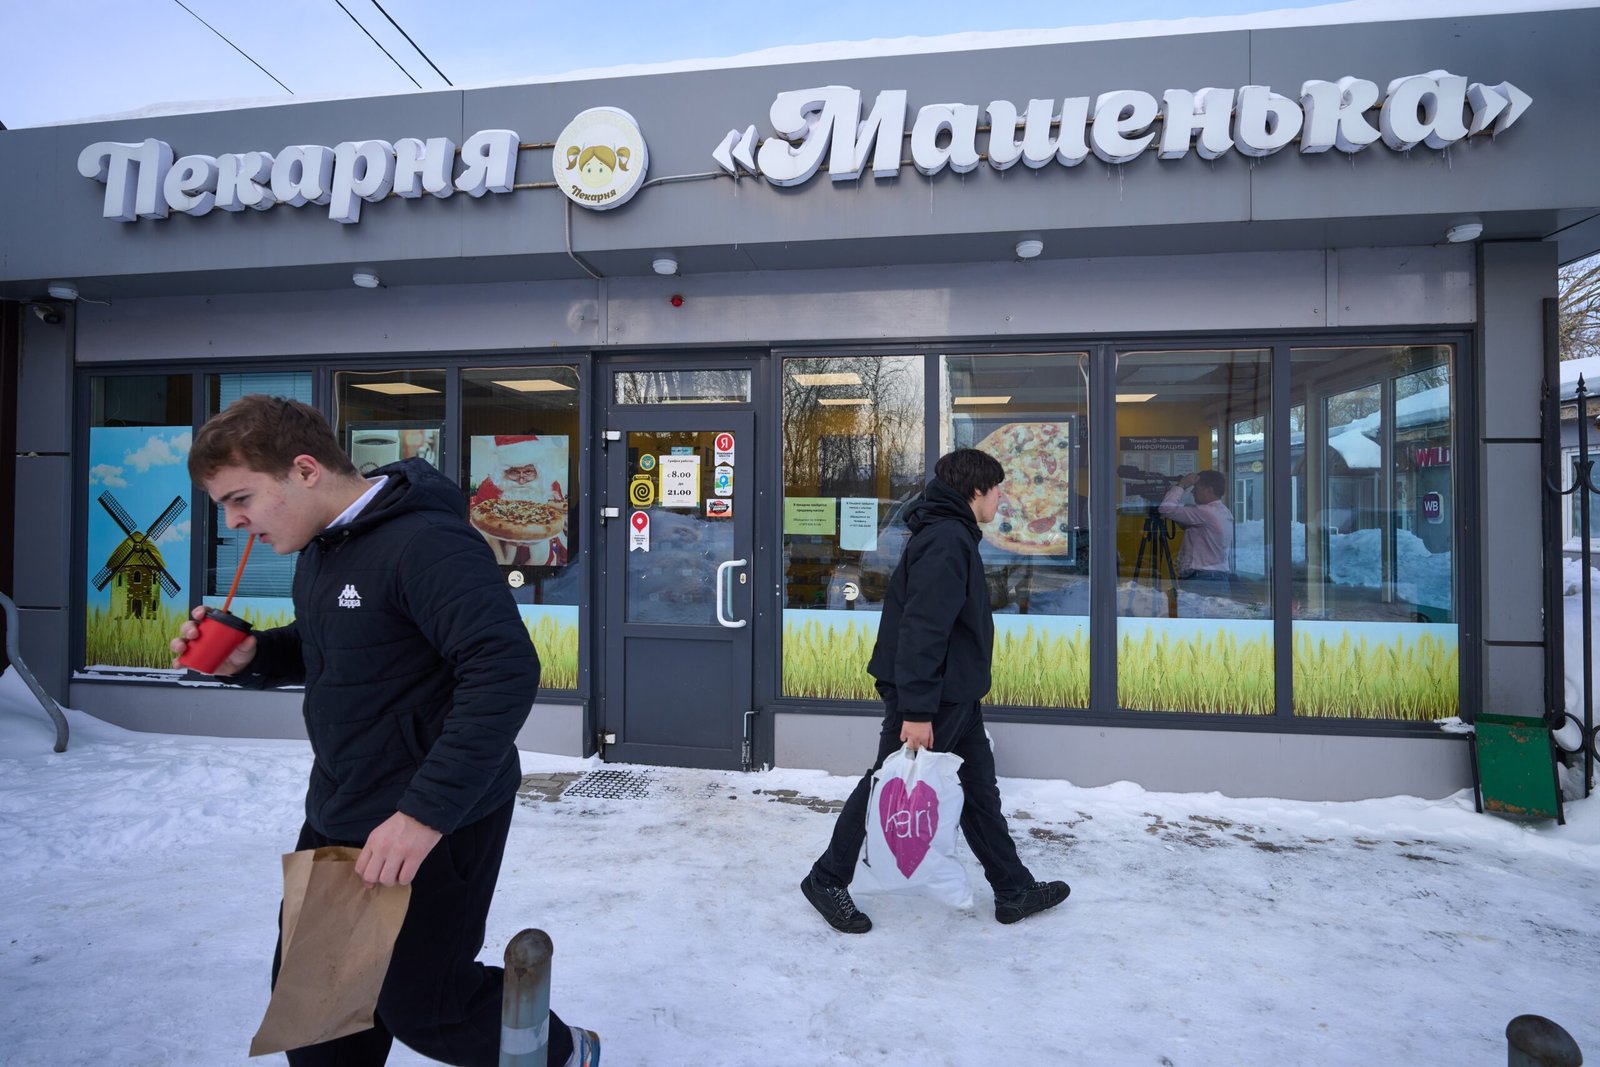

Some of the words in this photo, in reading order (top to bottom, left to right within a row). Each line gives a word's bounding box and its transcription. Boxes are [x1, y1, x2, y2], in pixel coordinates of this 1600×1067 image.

[77, 128, 521, 224] Пекарня
[711, 70, 1533, 188] «Машенька»
[571, 184, 617, 203] Пекарня
[671, 470, 691, 478] 8.00
[1424, 501, 1439, 512] WB
[338, 598, 361, 609] Kappa
[884, 793, 933, 839] kari
